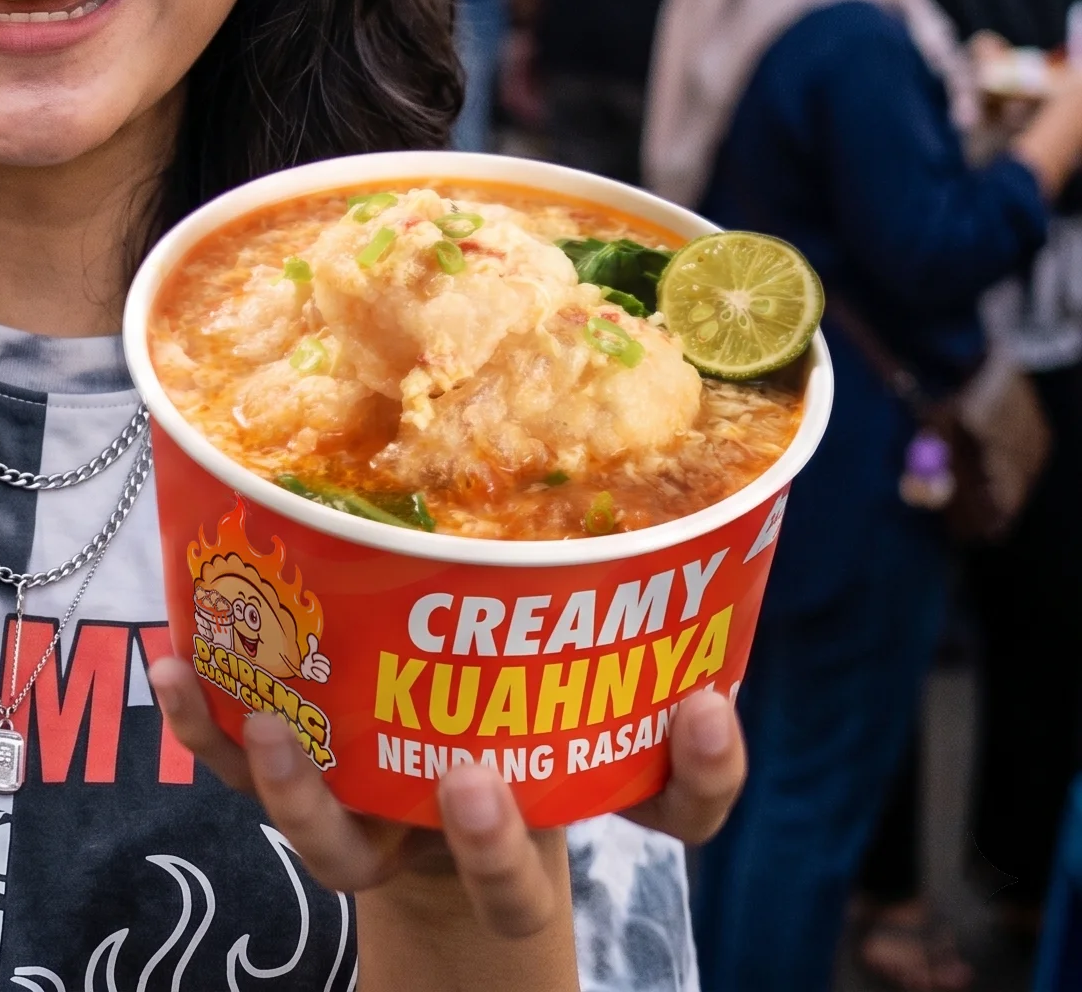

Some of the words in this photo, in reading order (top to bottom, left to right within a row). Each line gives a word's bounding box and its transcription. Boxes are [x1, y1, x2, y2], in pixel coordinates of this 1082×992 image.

[408, 547, 731, 656] CREAMY
[194, 656, 237, 696] KUAH
[240, 685, 332, 767] CRMY
[195, 636, 327, 747] D'CIRENG
[374, 603, 734, 737] KUAHNYA
[566, 681, 716, 775] RASAN
